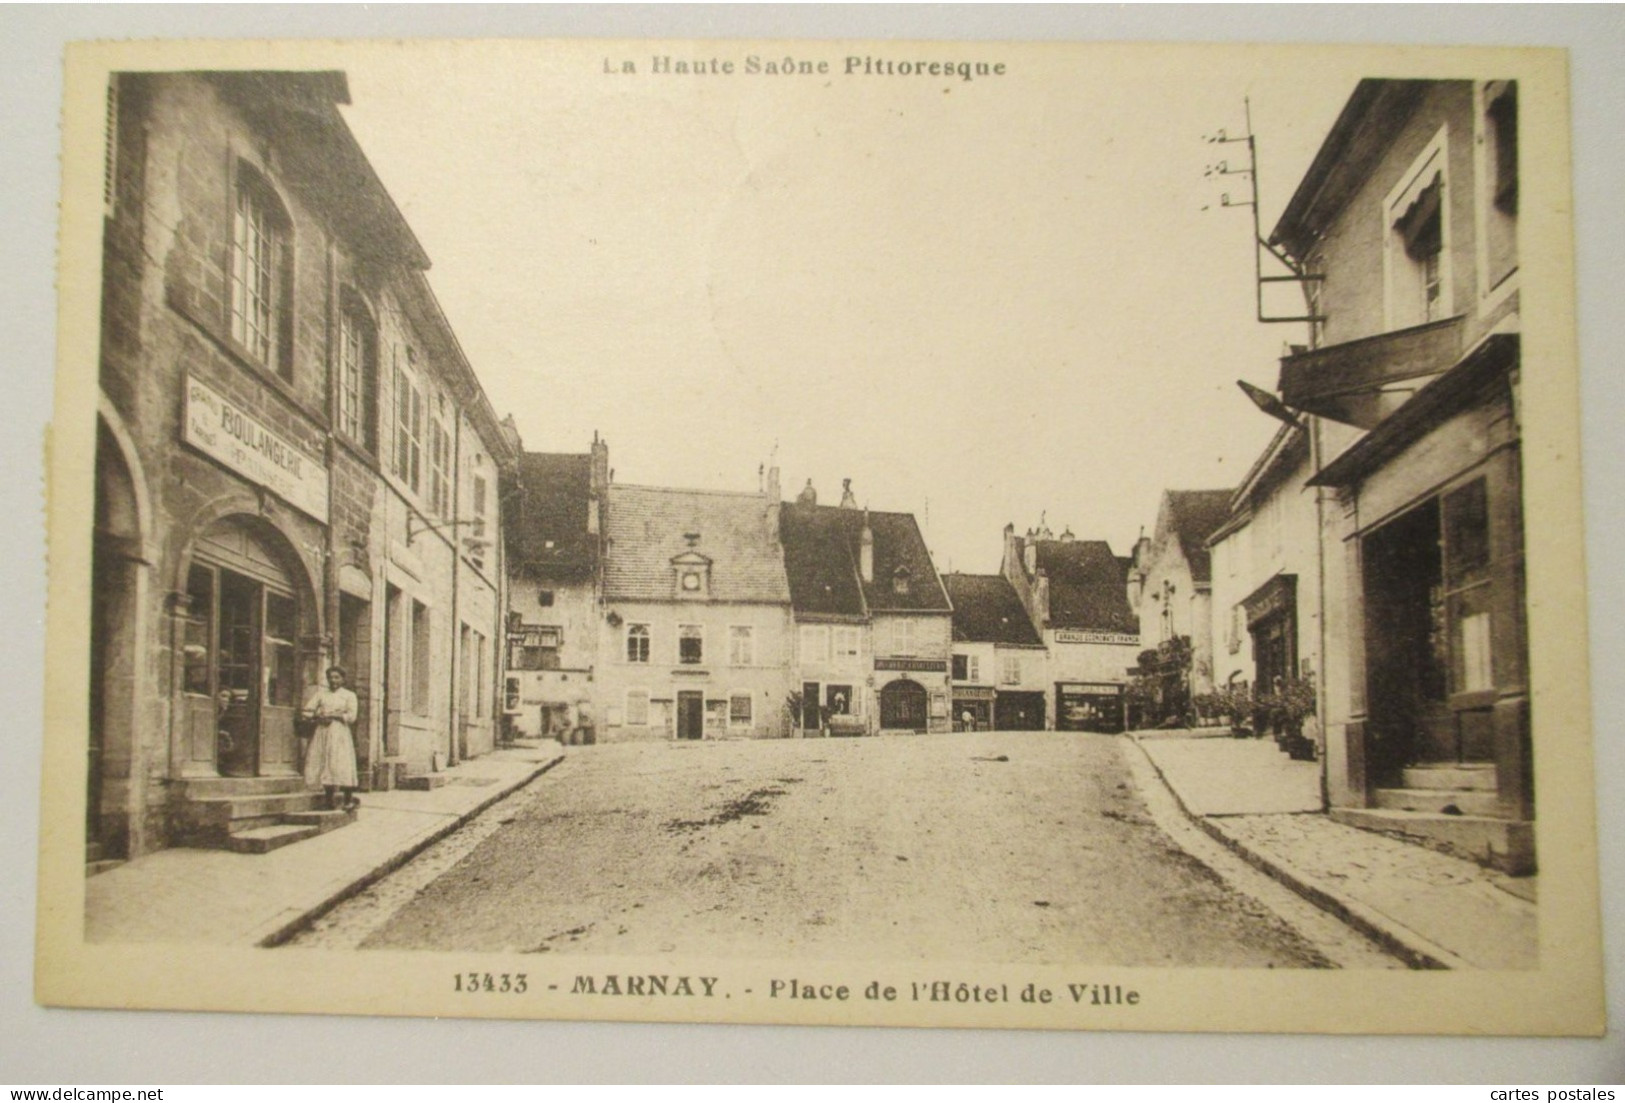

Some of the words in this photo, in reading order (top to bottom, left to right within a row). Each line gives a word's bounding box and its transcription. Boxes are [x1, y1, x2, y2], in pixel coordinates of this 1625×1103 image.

[651, 56, 735, 75] Haute
[745, 55, 829, 76] Saône
[844, 56, 1007, 82] Pittoresque
[220, 403, 304, 481] BOULANGERIE
[453, 973, 529, 994] 13433
[770, 979, 851, 1001] Place
[864, 981, 898, 1002] de
[911, 982, 1010, 1004] l'Hôtel
[1020, 983, 1053, 1005] de
[1068, 984, 1142, 1007] Ville
